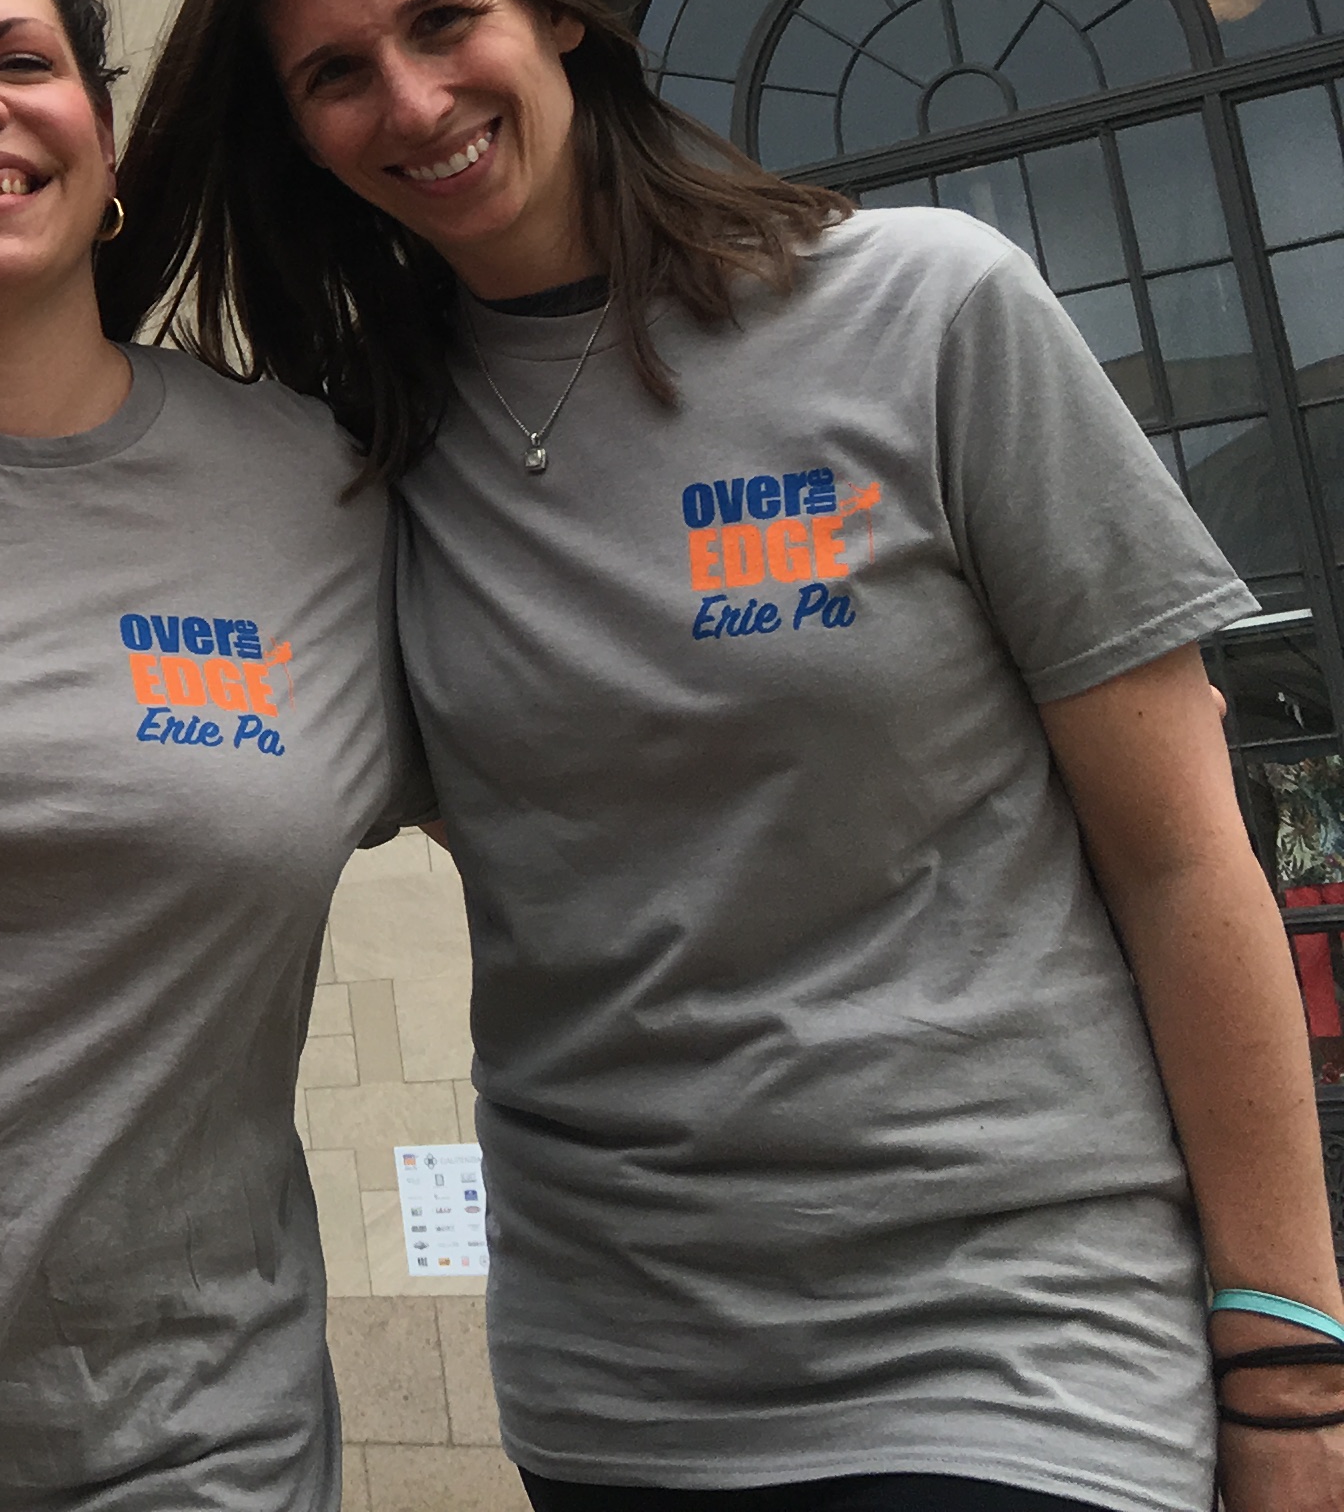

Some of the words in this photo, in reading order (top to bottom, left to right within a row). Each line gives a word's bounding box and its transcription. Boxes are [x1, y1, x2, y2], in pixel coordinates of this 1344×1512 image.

[688, 515, 850, 592] EDGE
[232, 619, 262, 659] the
[692, 593, 782, 641] Erie
[792, 582, 856, 630] Pa
[128, 653, 279, 718] EDGE
[136, 706, 224, 747] Erie
[233, 714, 285, 756] Pa
